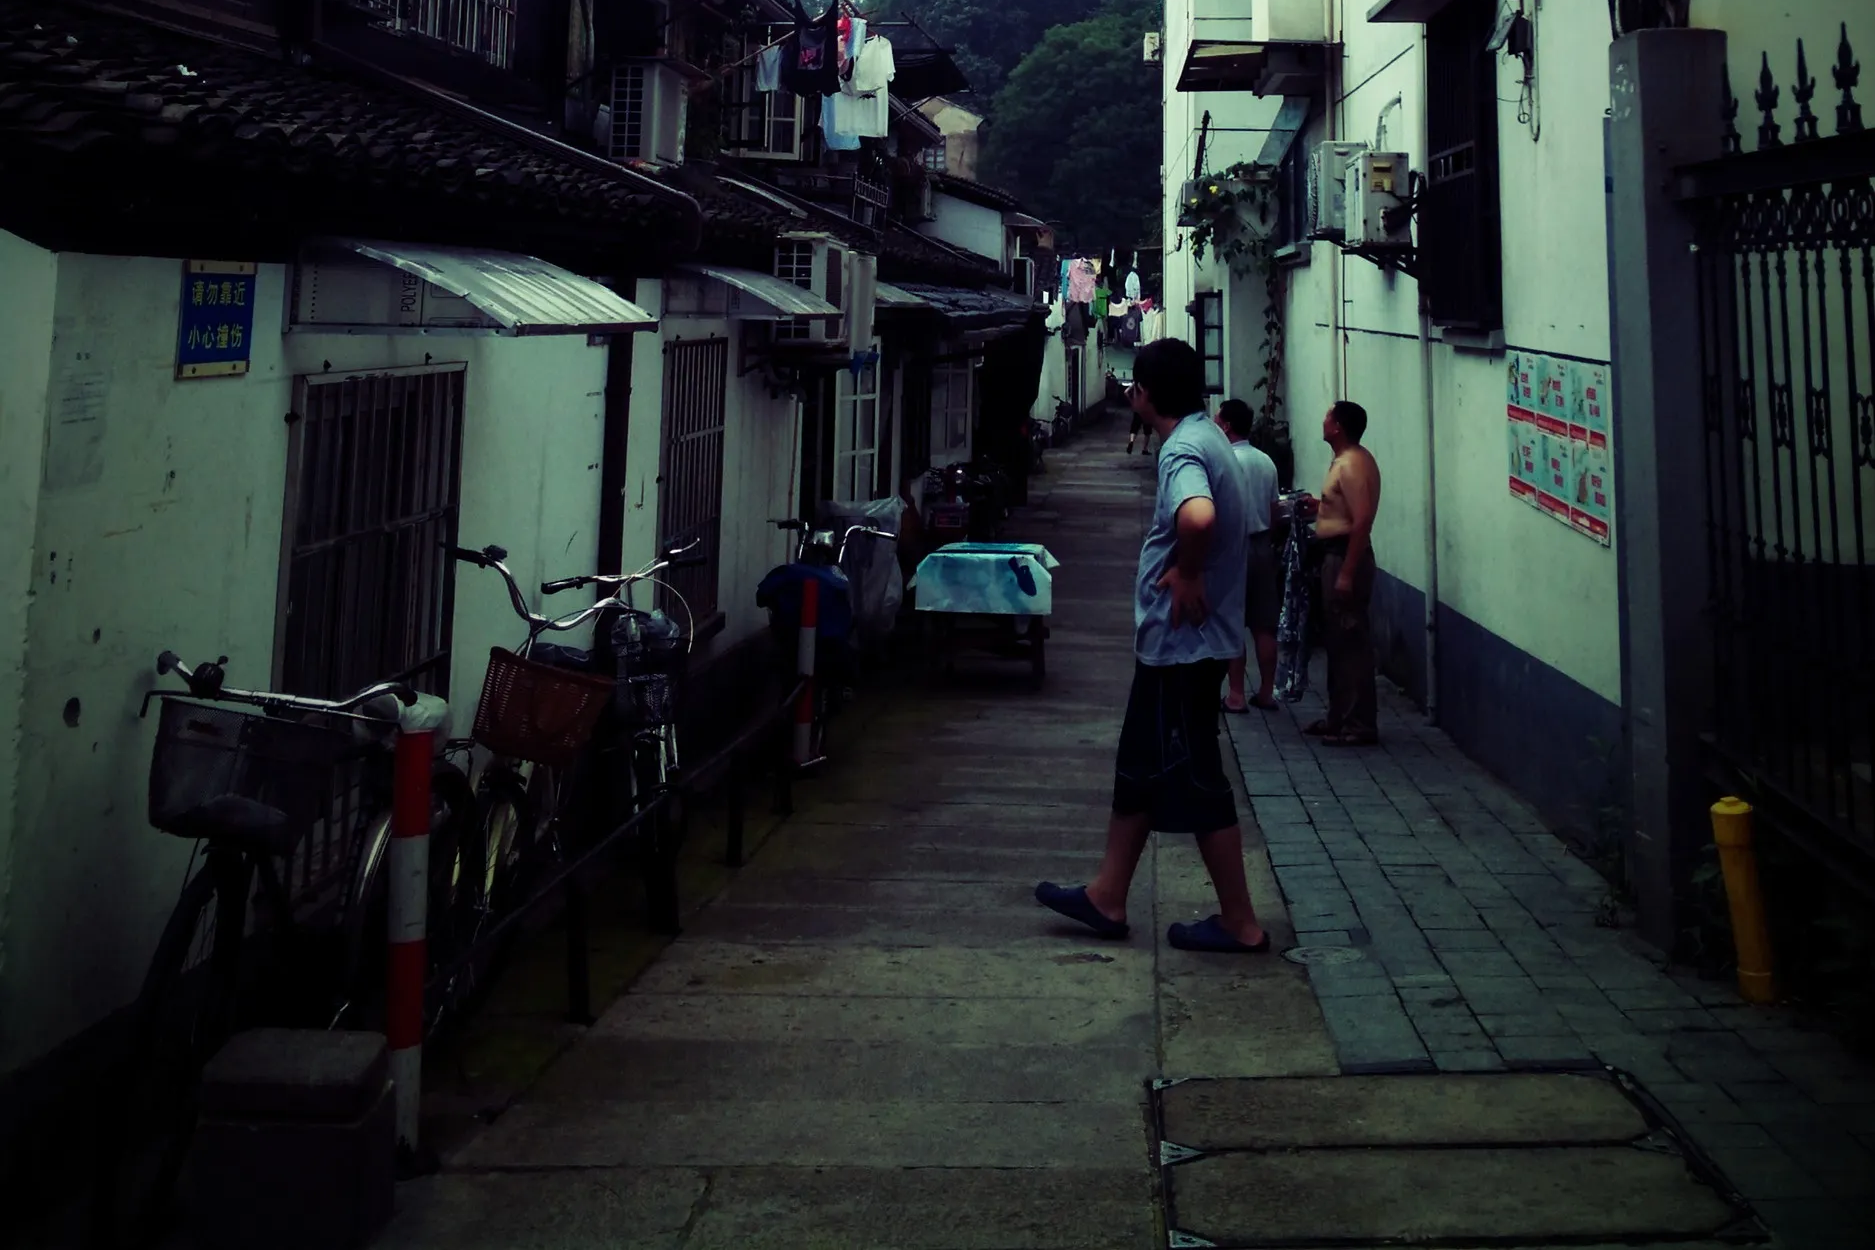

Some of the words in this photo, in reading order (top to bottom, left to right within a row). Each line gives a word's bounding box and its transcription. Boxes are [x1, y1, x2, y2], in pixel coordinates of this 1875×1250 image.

[191, 280, 246, 306] 请勿靠近
[187, 323, 243, 350] 小心撞伤
